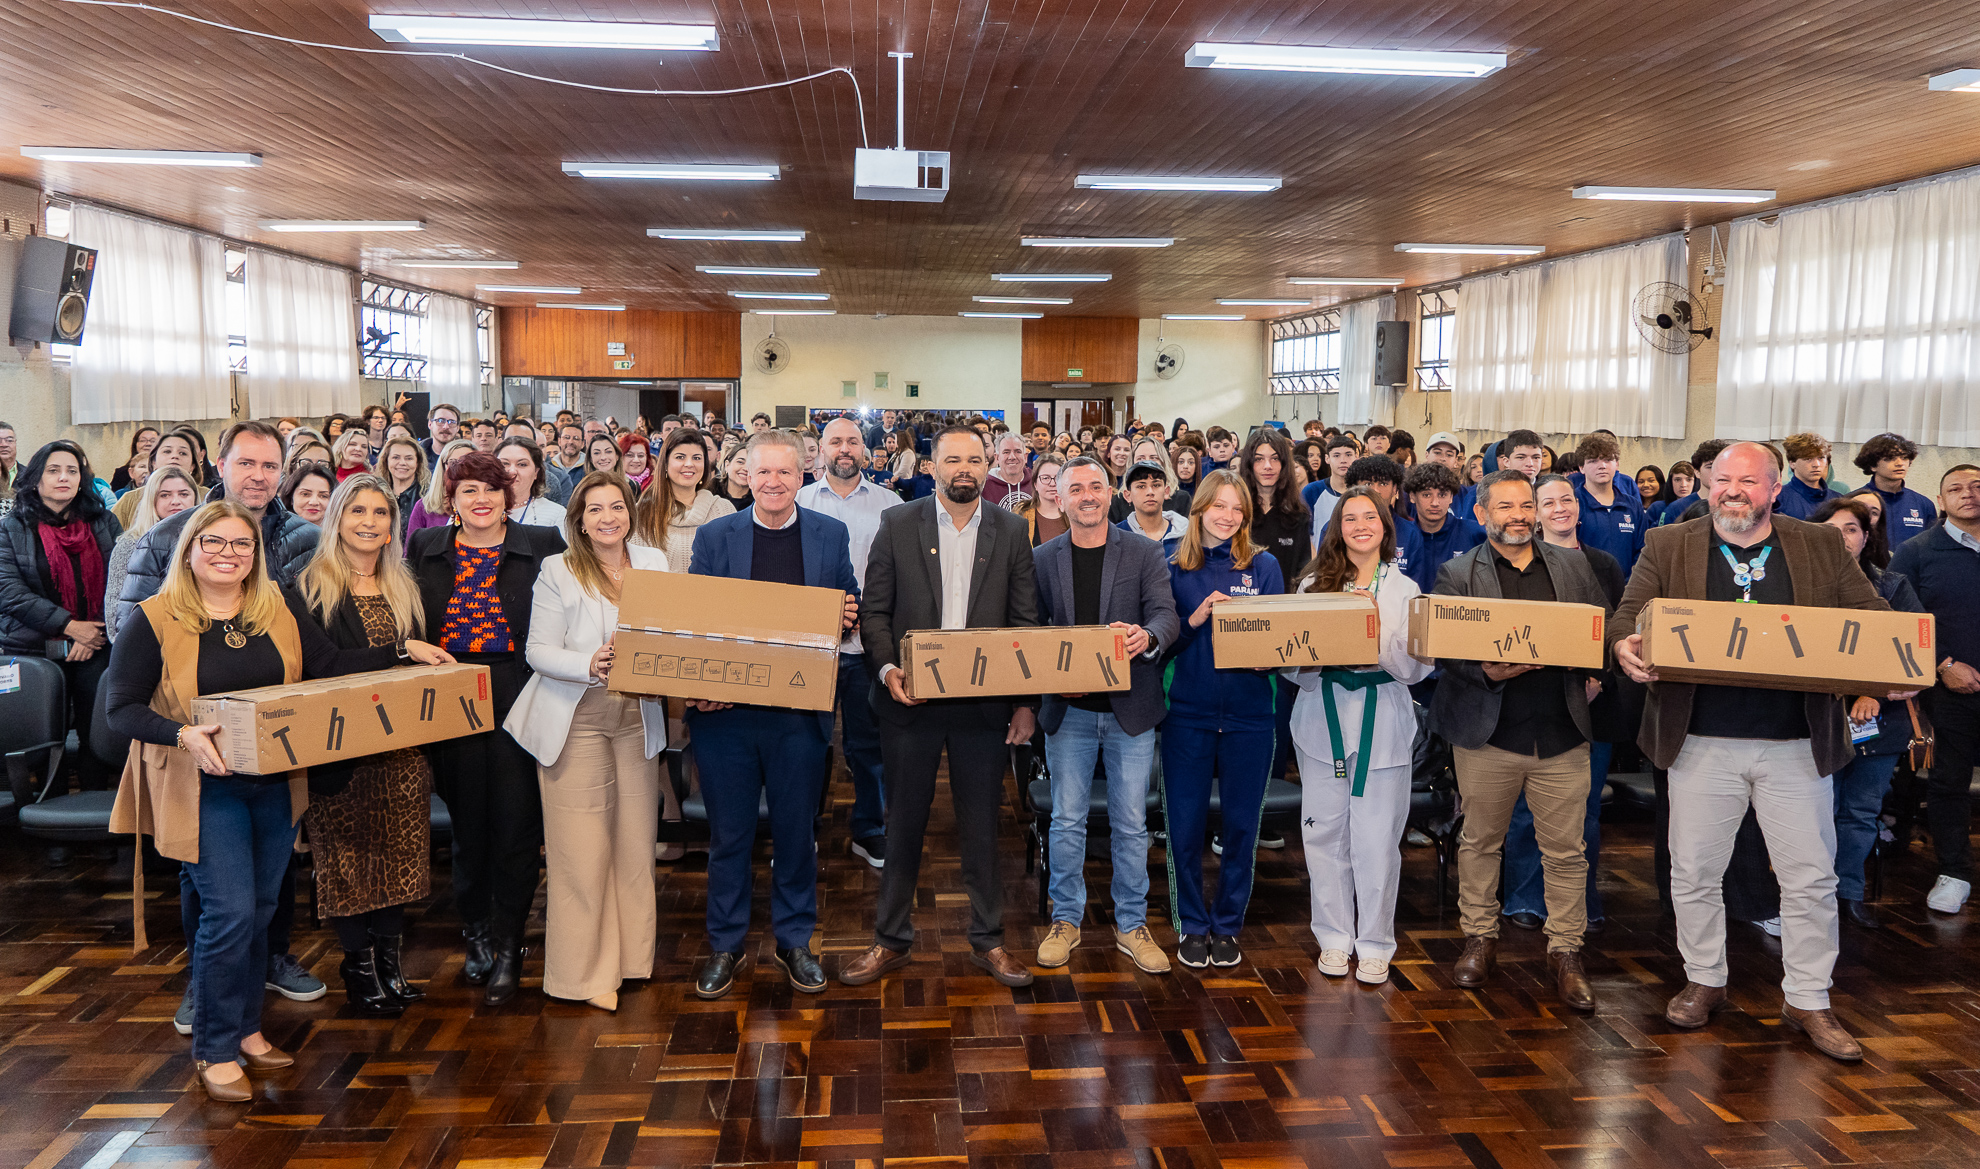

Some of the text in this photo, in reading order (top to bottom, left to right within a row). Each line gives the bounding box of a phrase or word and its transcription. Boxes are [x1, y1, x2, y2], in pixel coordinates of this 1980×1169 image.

[1230, 586, 1260, 596] PARAN
[1434, 604, 1490, 622] ThinkCentre
[1661, 605, 1694, 616] ThinkVision
[1218, 617, 1271, 633] ThinkCentre
[916, 642, 943, 651] ThinkVision
[1275, 630, 1319, 663] Think
[1493, 625, 1539, 659] Think
[1671, 613, 1924, 679] Think
[924, 640, 1120, 694] Think
[262, 707, 296, 720] ThinkVision
[272, 688, 484, 766] Think
